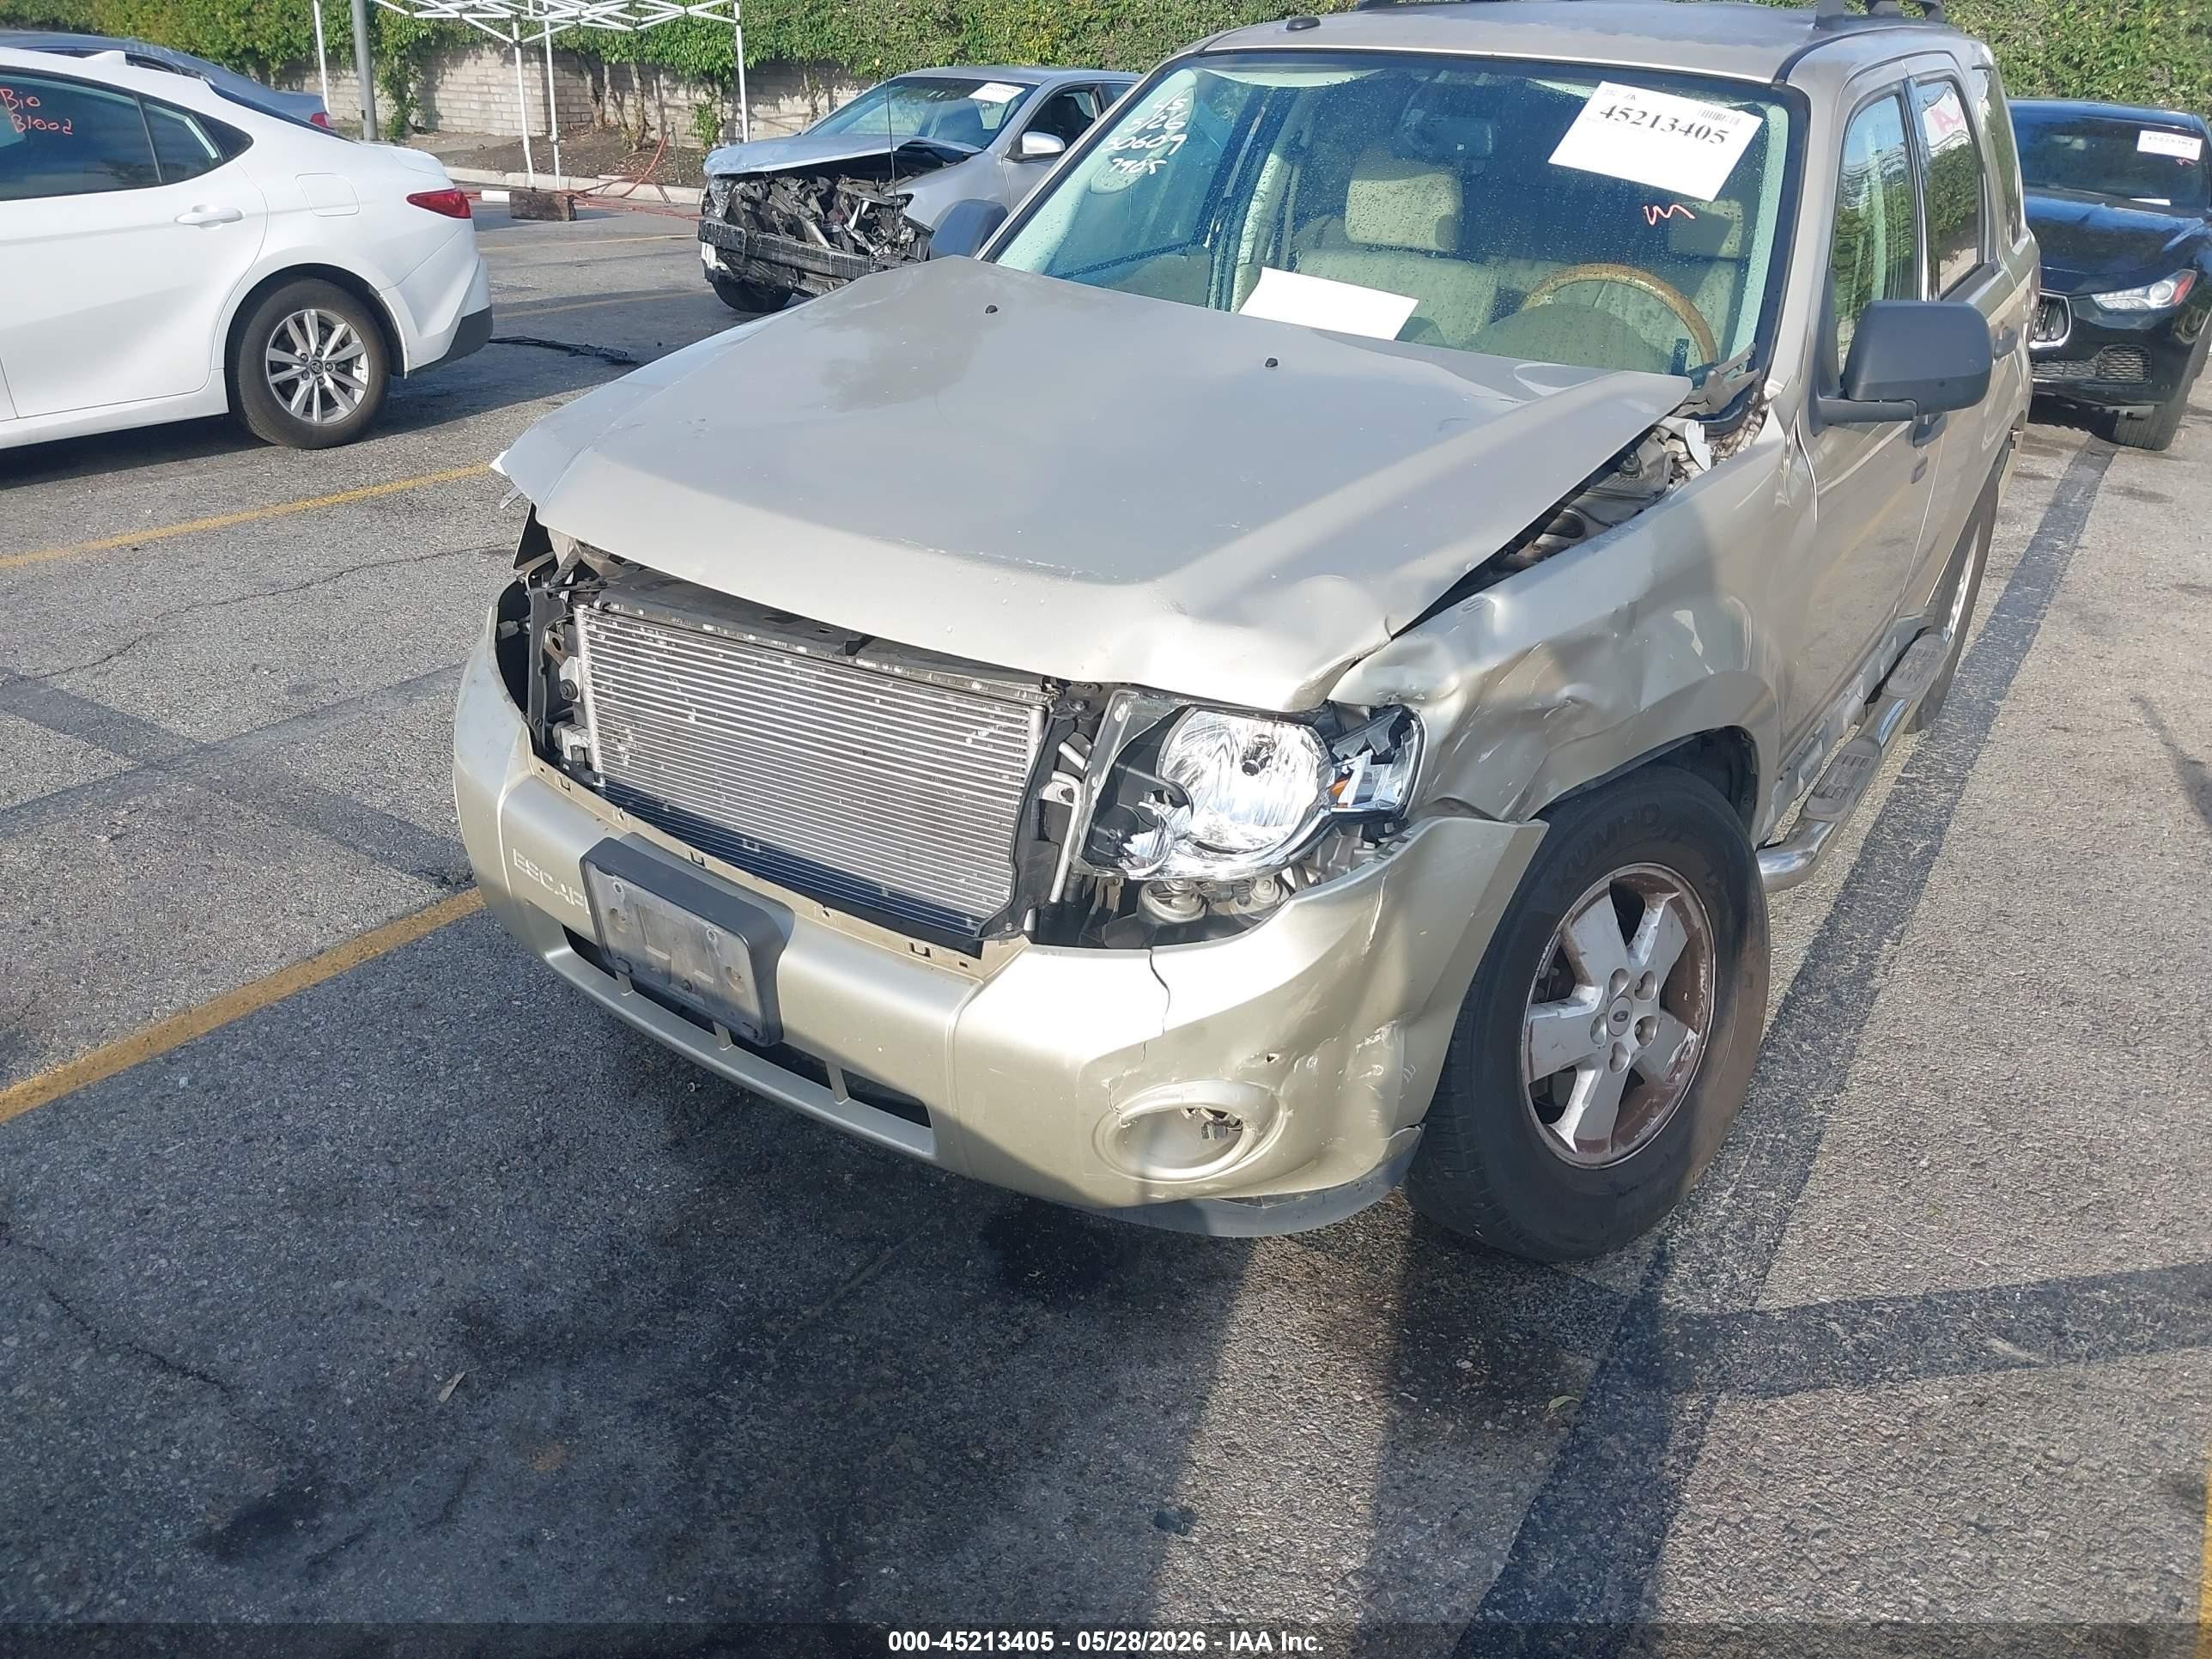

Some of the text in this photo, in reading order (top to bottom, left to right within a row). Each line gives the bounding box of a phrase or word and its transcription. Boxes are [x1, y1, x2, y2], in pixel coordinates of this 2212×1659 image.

[0, 88, 41, 111] Bio
[1600, 104, 1730, 144] 45213405
[1101, 133, 1188, 155] 30609
[512, 847, 591, 915] ESCAP
